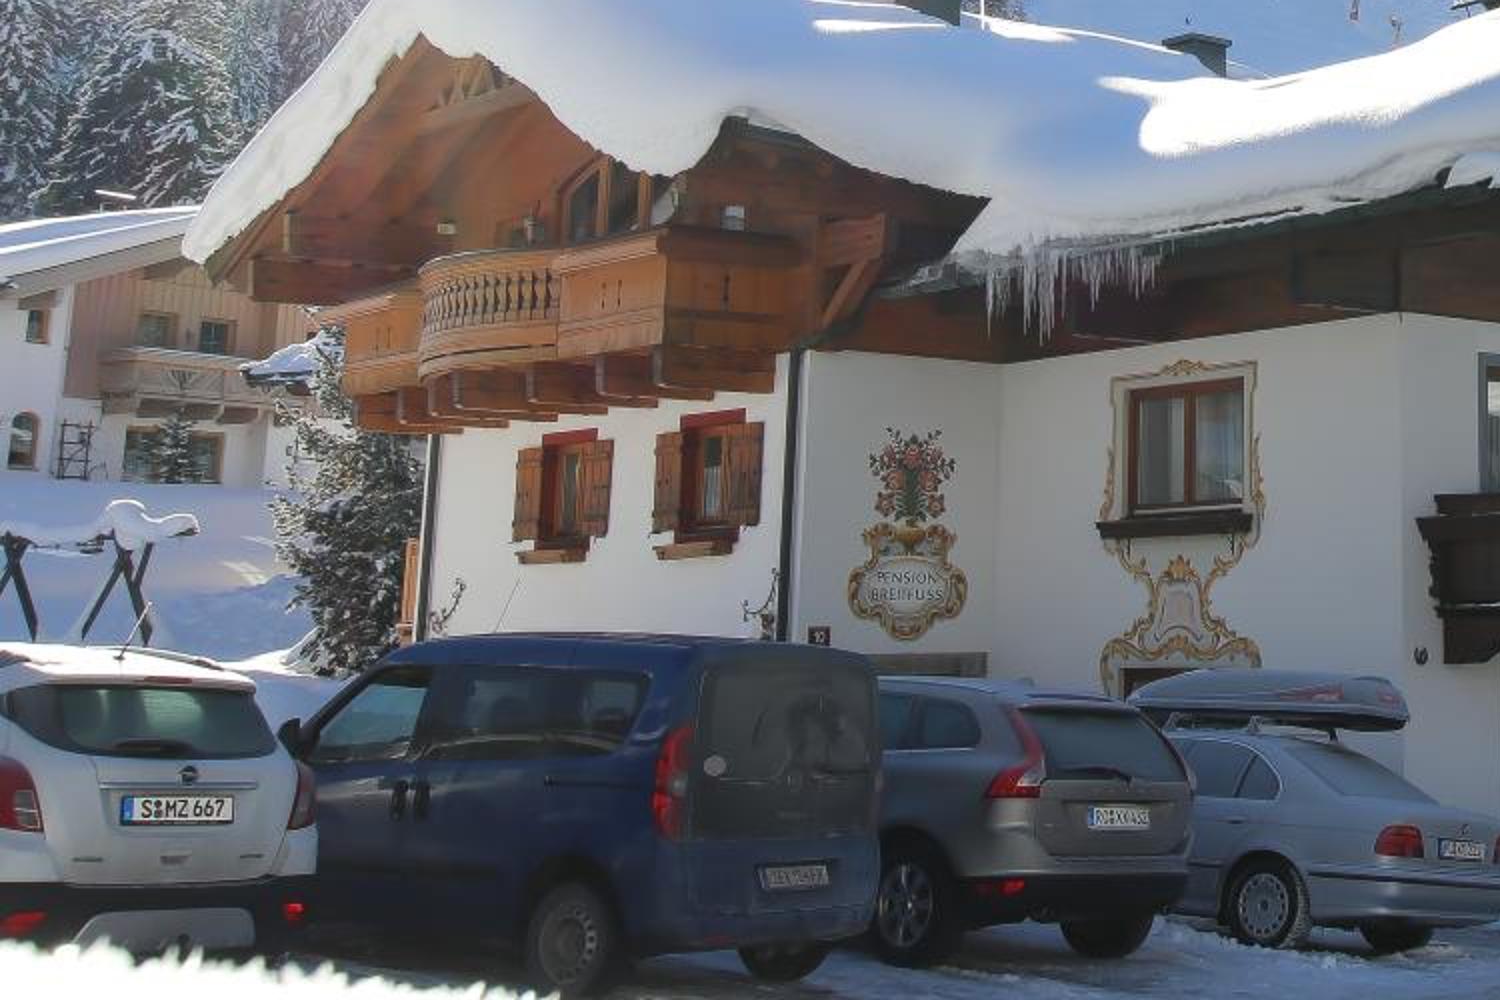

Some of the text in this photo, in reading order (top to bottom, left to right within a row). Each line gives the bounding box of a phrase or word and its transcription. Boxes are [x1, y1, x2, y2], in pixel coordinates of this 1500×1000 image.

[877, 571, 938, 584] PENSION
[165, 799, 188, 818] MZ
[193, 799, 225, 818] 667
